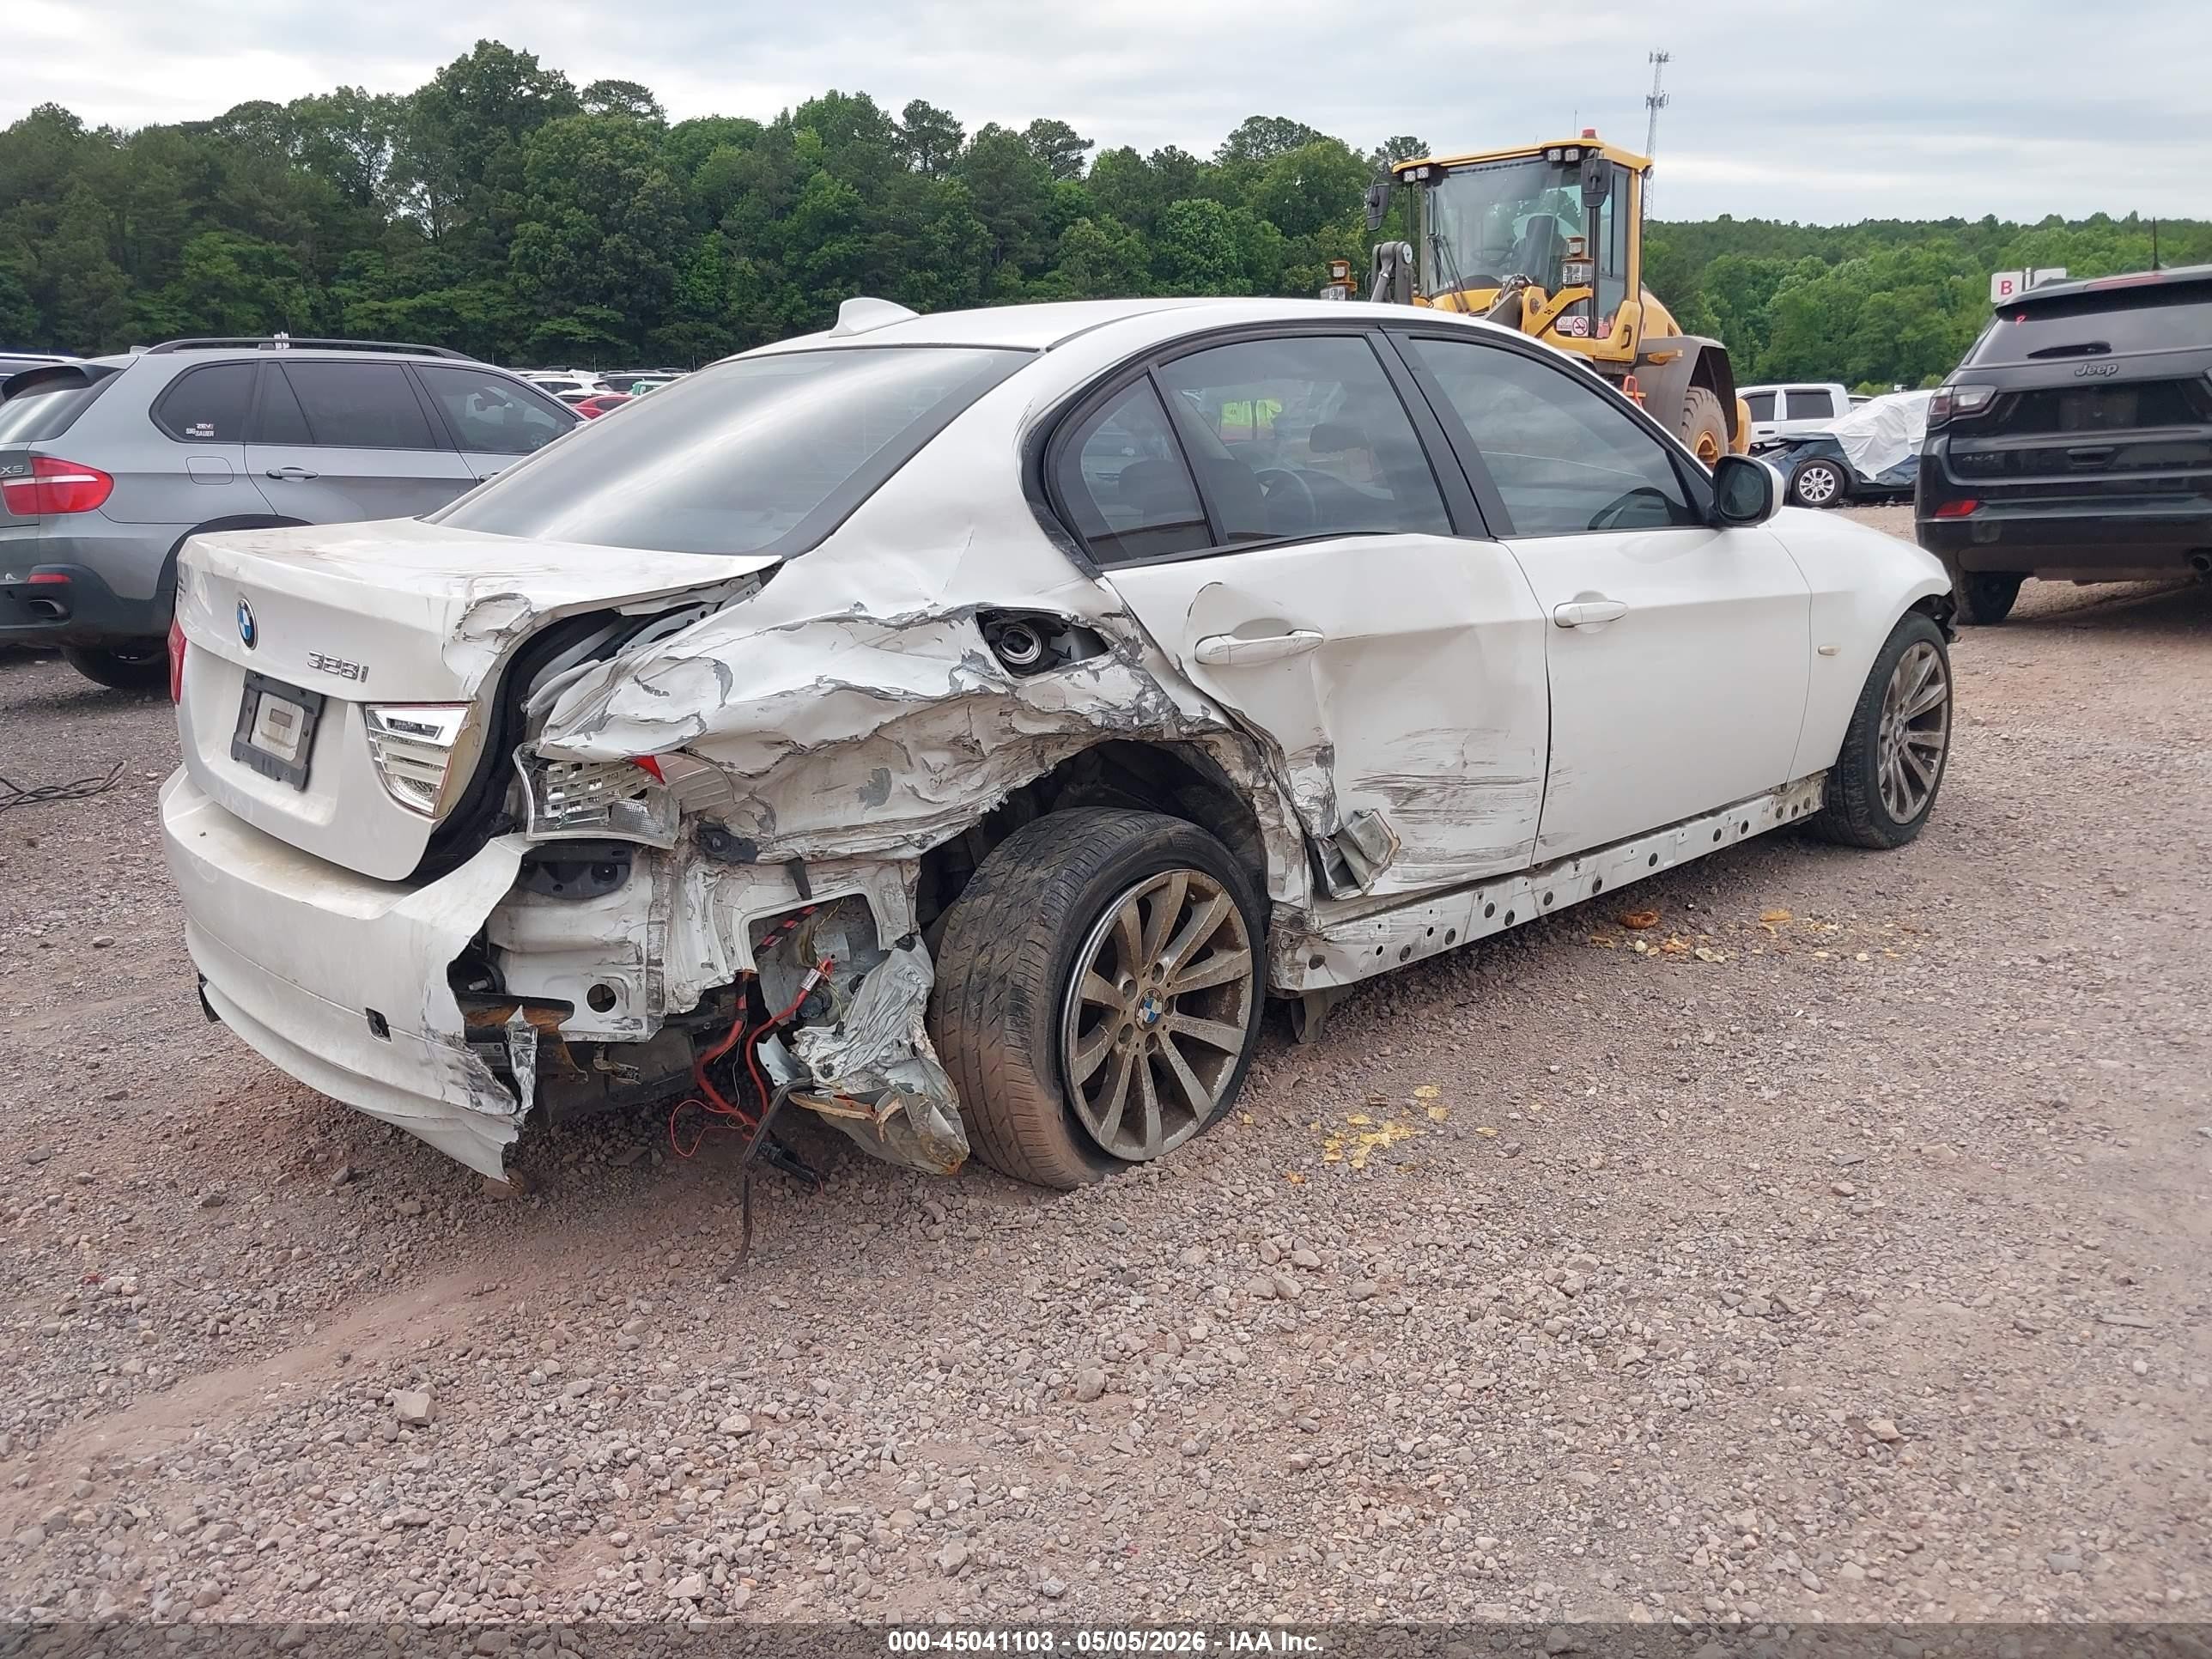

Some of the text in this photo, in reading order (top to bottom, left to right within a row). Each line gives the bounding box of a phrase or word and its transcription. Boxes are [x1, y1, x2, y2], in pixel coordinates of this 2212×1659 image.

[2000, 280, 2013, 295] B
[2074, 363, 2119, 377] Jeep
[0, 465, 24, 475] X5
[307, 650, 369, 683] 328i
